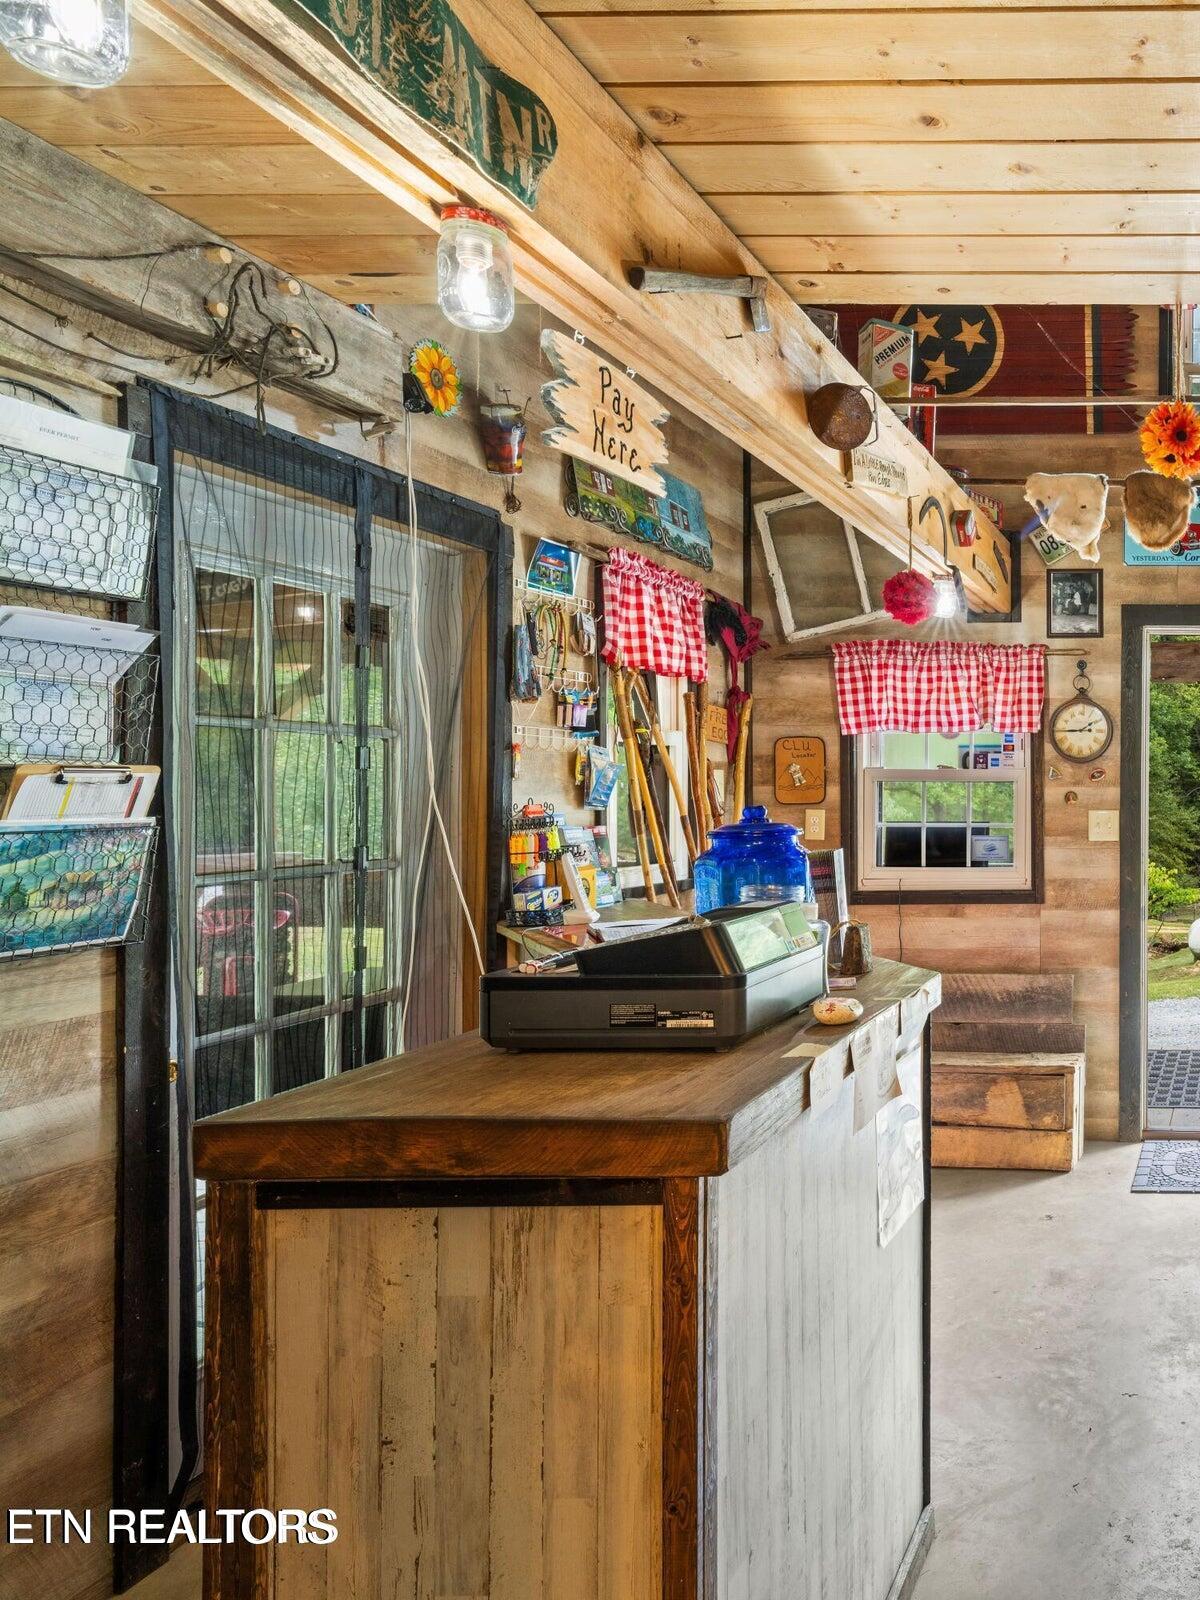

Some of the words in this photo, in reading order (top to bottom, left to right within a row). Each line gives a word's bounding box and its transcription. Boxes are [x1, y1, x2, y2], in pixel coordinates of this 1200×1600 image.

[873, 335, 911, 365] PREMIUM
[599, 365, 635, 433] Pay
[593, 409, 641, 472] Here
[1040, 535, 1066, 555] 08
